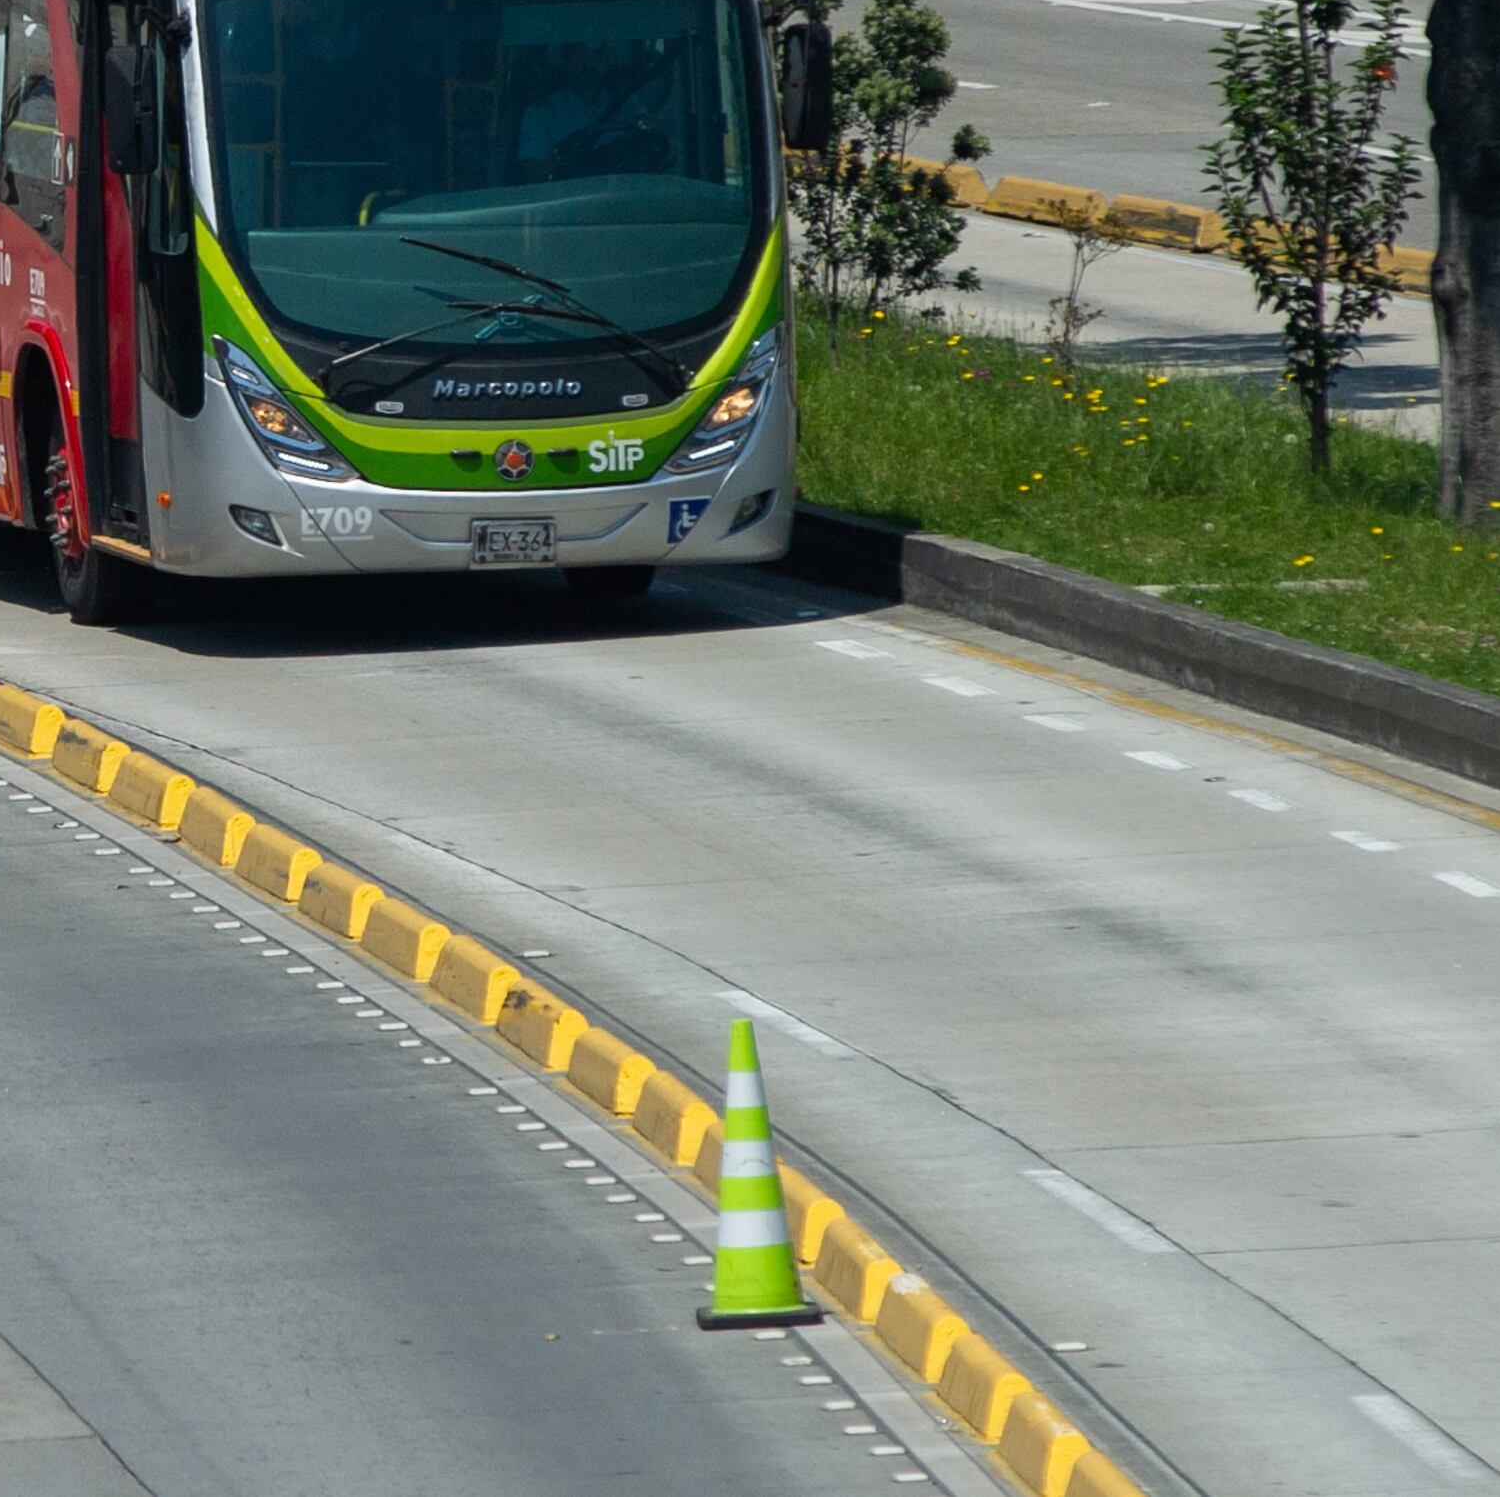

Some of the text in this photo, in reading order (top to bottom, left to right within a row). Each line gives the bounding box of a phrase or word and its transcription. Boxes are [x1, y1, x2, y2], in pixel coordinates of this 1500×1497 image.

[432, 378, 582, 399] Marcopolo
[300, 506, 373, 536] E709
[477, 529, 553, 553] WEX-364
